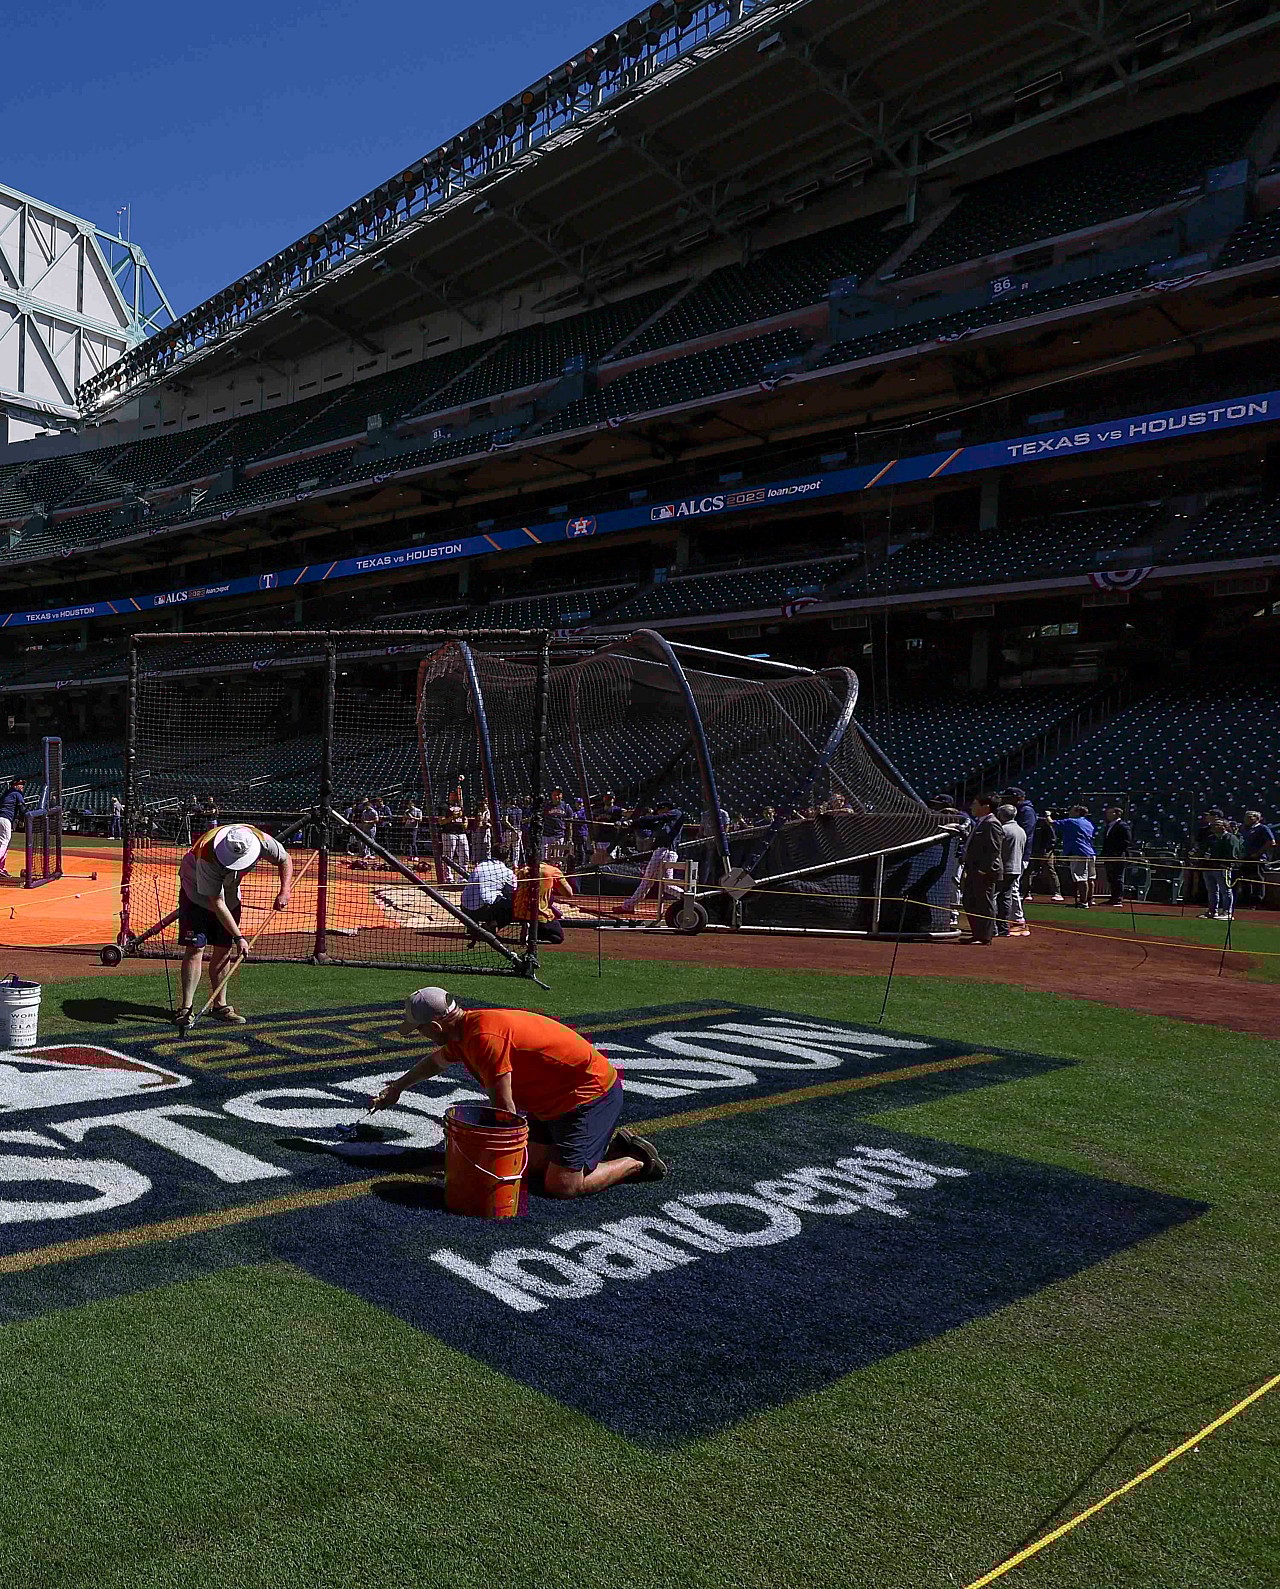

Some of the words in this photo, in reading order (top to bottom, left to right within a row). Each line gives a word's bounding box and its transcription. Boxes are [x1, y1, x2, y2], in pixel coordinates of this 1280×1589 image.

[993, 279, 1011, 293] 86
[1007, 432, 1091, 457] TEXAS
[1129, 400, 1269, 437] HOUSTON
[676, 496, 725, 517] ALCS
[726, 491, 765, 504] 2023
[767, 480, 822, 497] loanDepot
[356, 556, 392, 569] TEXAS
[406, 543, 462, 561] HOUSTON
[165, 591, 188, 604] ALCS
[26, 612, 51, 622] TEXAS
[60, 607, 95, 618] HOUSTON
[429, 1144, 971, 1312] loanDepot
